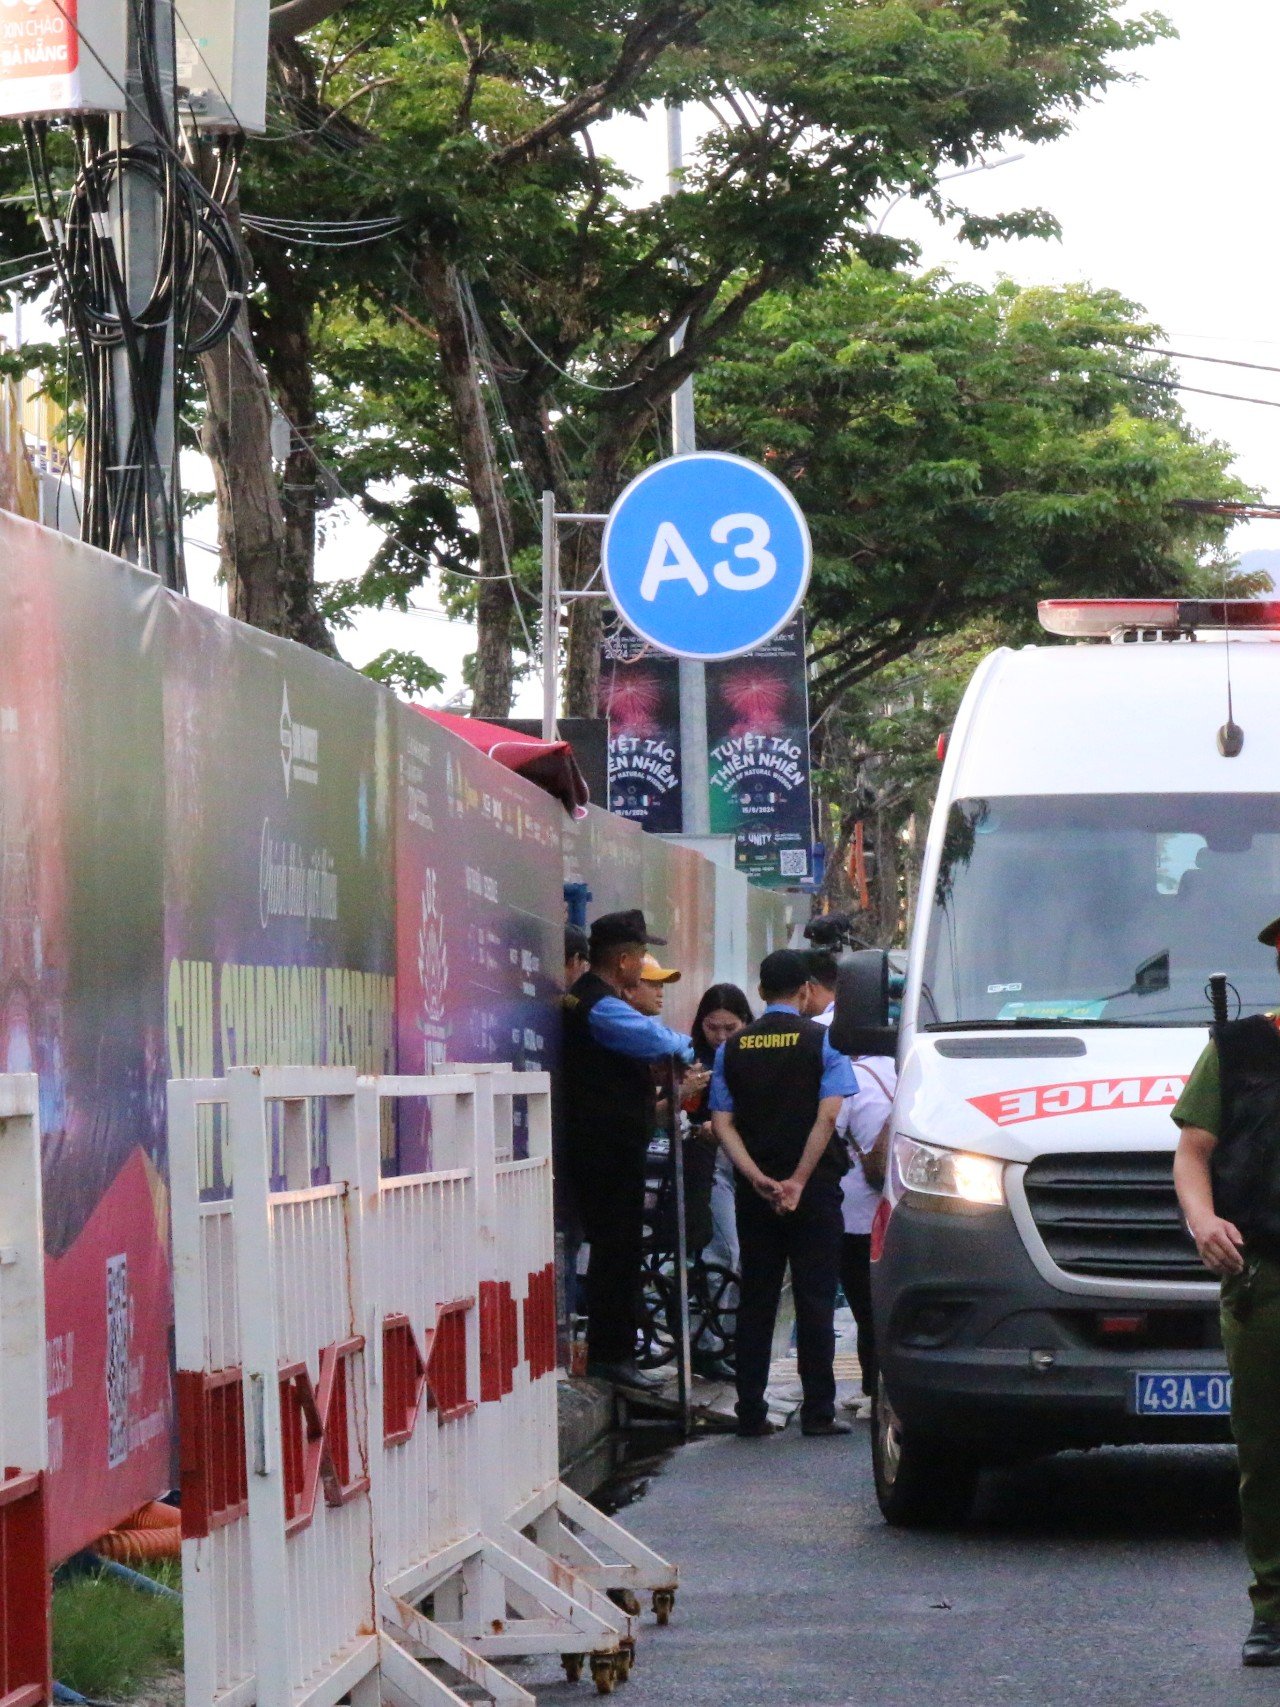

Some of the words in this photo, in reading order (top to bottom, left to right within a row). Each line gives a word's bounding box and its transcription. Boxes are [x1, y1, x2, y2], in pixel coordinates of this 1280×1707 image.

[640, 512, 777, 602] A3
[645, 740, 676, 762] TÁC
[710, 732, 766, 761] TUYỆT
[771, 738, 802, 760] TÁC
[632, 755, 679, 789] NHIÊN
[710, 753, 755, 786] THIÊN
[758, 753, 805, 786] NHIÊN
[739, 1032, 800, 1050] SECURITY
